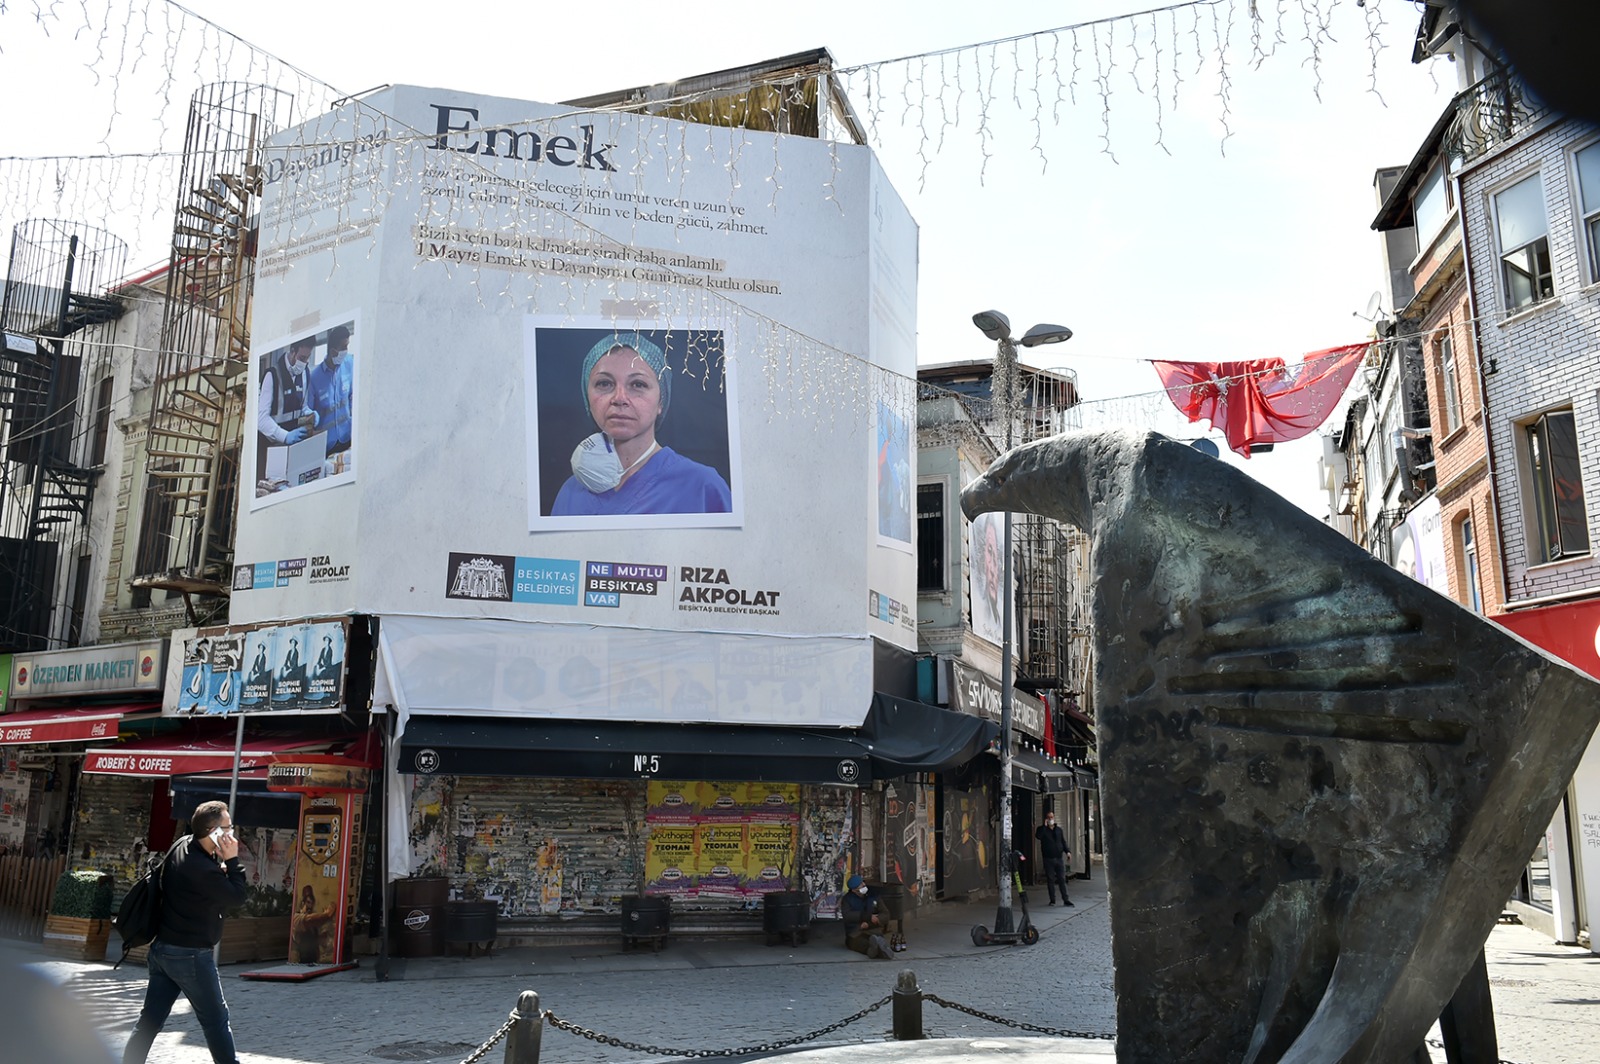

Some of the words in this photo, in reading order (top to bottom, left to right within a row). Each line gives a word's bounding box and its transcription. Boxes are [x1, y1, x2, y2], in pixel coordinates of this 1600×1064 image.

[427, 104, 618, 172] Emek
[266, 129, 387, 186] Dayanışma
[528, 179, 584, 197] geleceği
[586, 186, 610, 200] için
[614, 192, 650, 204] umut
[653, 196, 689, 209] veren
[693, 202, 727, 214] uzun
[730, 205, 746, 216] ve
[572, 200, 611, 217] Zihin
[614, 209, 630, 219] ve
[634, 208, 674, 224] beden
[676, 215, 714, 231] gücü,
[717, 219, 768, 236] zahmet.
[419, 225, 460, 242] Bizim
[465, 229, 489, 246] için
[494, 233, 522, 248] bazı
[527, 237, 589, 257] kelimeler
[592, 246, 630, 263] şimdi
[633, 249, 666, 265] daha
[669, 256, 723, 272] anlamlı.
[417, 242, 424, 256] 1
[428, 243, 480, 264] Mayıs
[485, 250, 527, 268] Emek
[531, 258, 550, 271] ve
[551, 258, 627, 279] Dayanışma
[706, 275, 740, 290] kutlu
[743, 279, 782, 296] olsun.
[311, 555, 330, 566] RIZA
[310, 566, 350, 579] AKPOLAT
[517, 569, 576, 583] BEŞİKTAŞ
[591, 564, 609, 576] NE
[617, 565, 664, 579] MUTLU
[680, 566, 731, 585] RIZA
[516, 582, 576, 596] BELEDİYESİ
[590, 579, 655, 594] BEŞİKTAŞ
[589, 593, 617, 605] VAR
[679, 586, 780, 607] AKPOLAT
[678, 604, 713, 614] BEŞİKTAŞ
[714, 605, 748, 615] BELEDİYE
[749, 607, 780, 617] BAŞKANI
[32, 664, 83, 685] ÖZERDEN
[85, 659, 134, 682] MARKET
[278, 680, 300, 688] SOPHIE
[6, 728, 33, 740] COFFEE
[96, 756, 135, 770] ROBERT'S
[139, 758, 173, 771] COFFEE
[651, 831, 693, 841] youthopia
